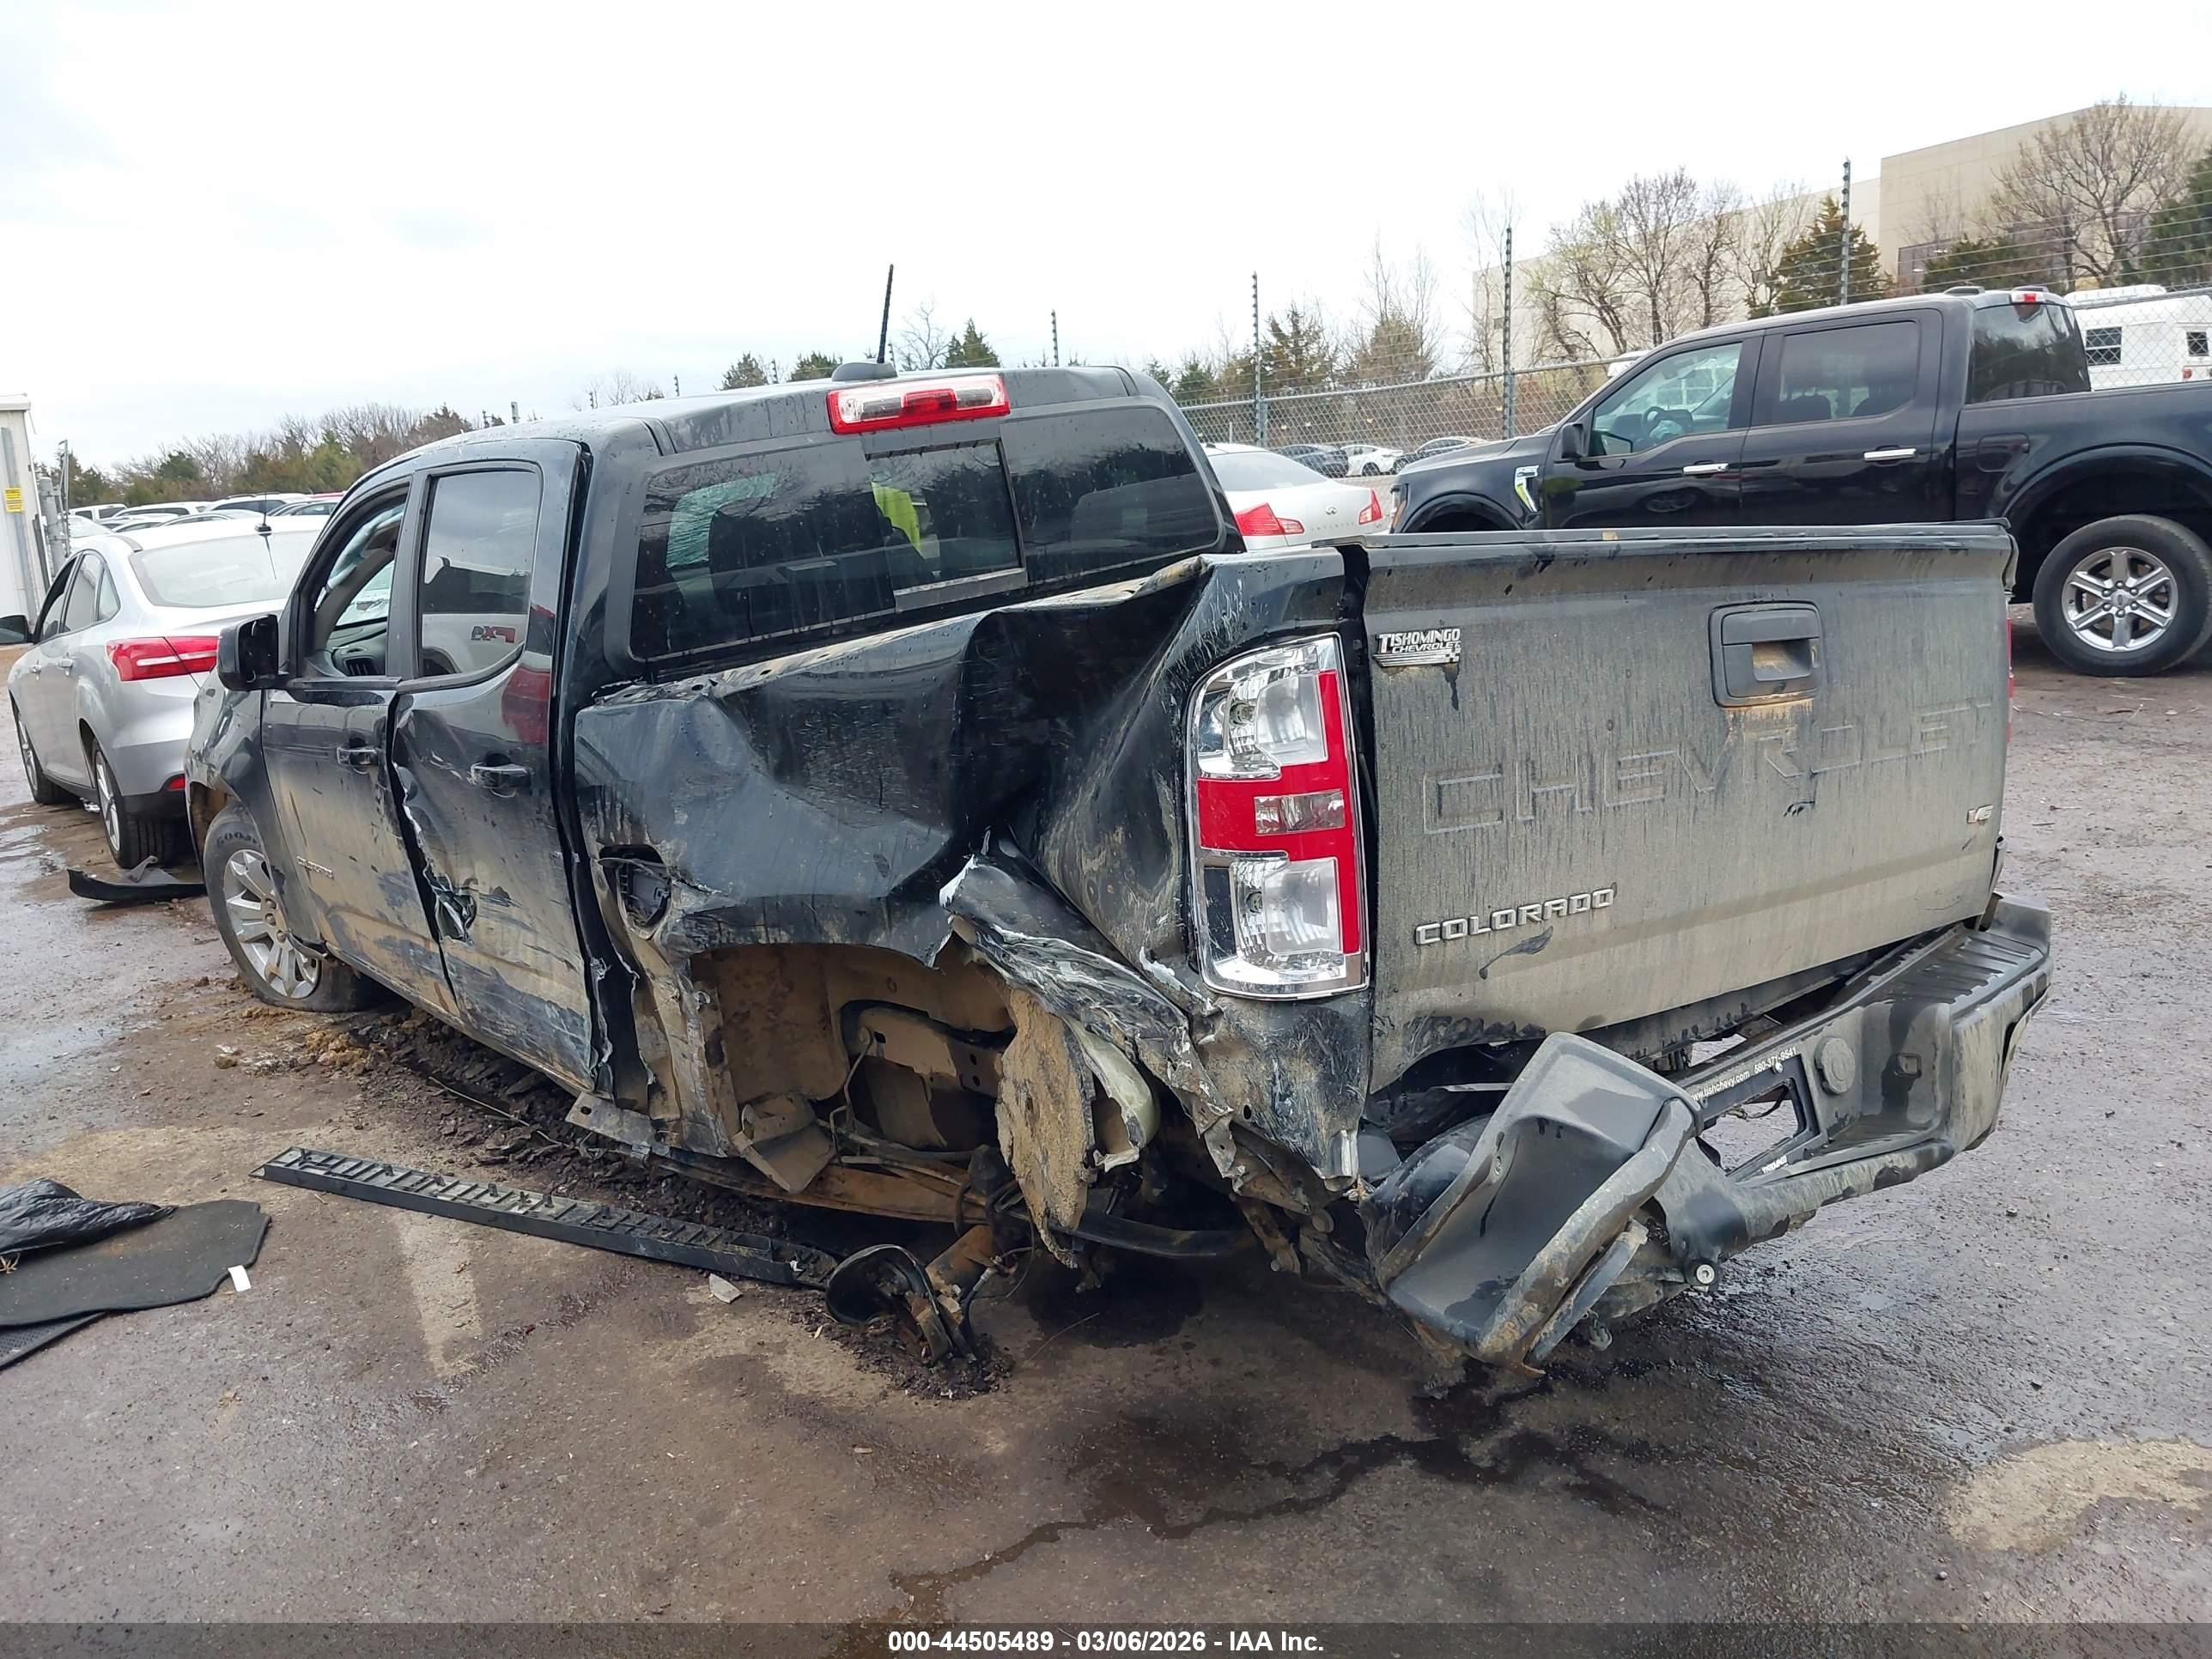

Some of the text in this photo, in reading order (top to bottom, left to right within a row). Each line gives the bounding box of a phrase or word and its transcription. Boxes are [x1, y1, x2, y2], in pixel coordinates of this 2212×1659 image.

[1378, 628, 1461, 653] TISHOMINGO
[1391, 641, 1462, 653] CHEVROLET
[1423, 696, 1993, 834] CHEVROLET
[1967, 805, 1993, 823] V6
[1415, 888, 1614, 945] COLORADO
